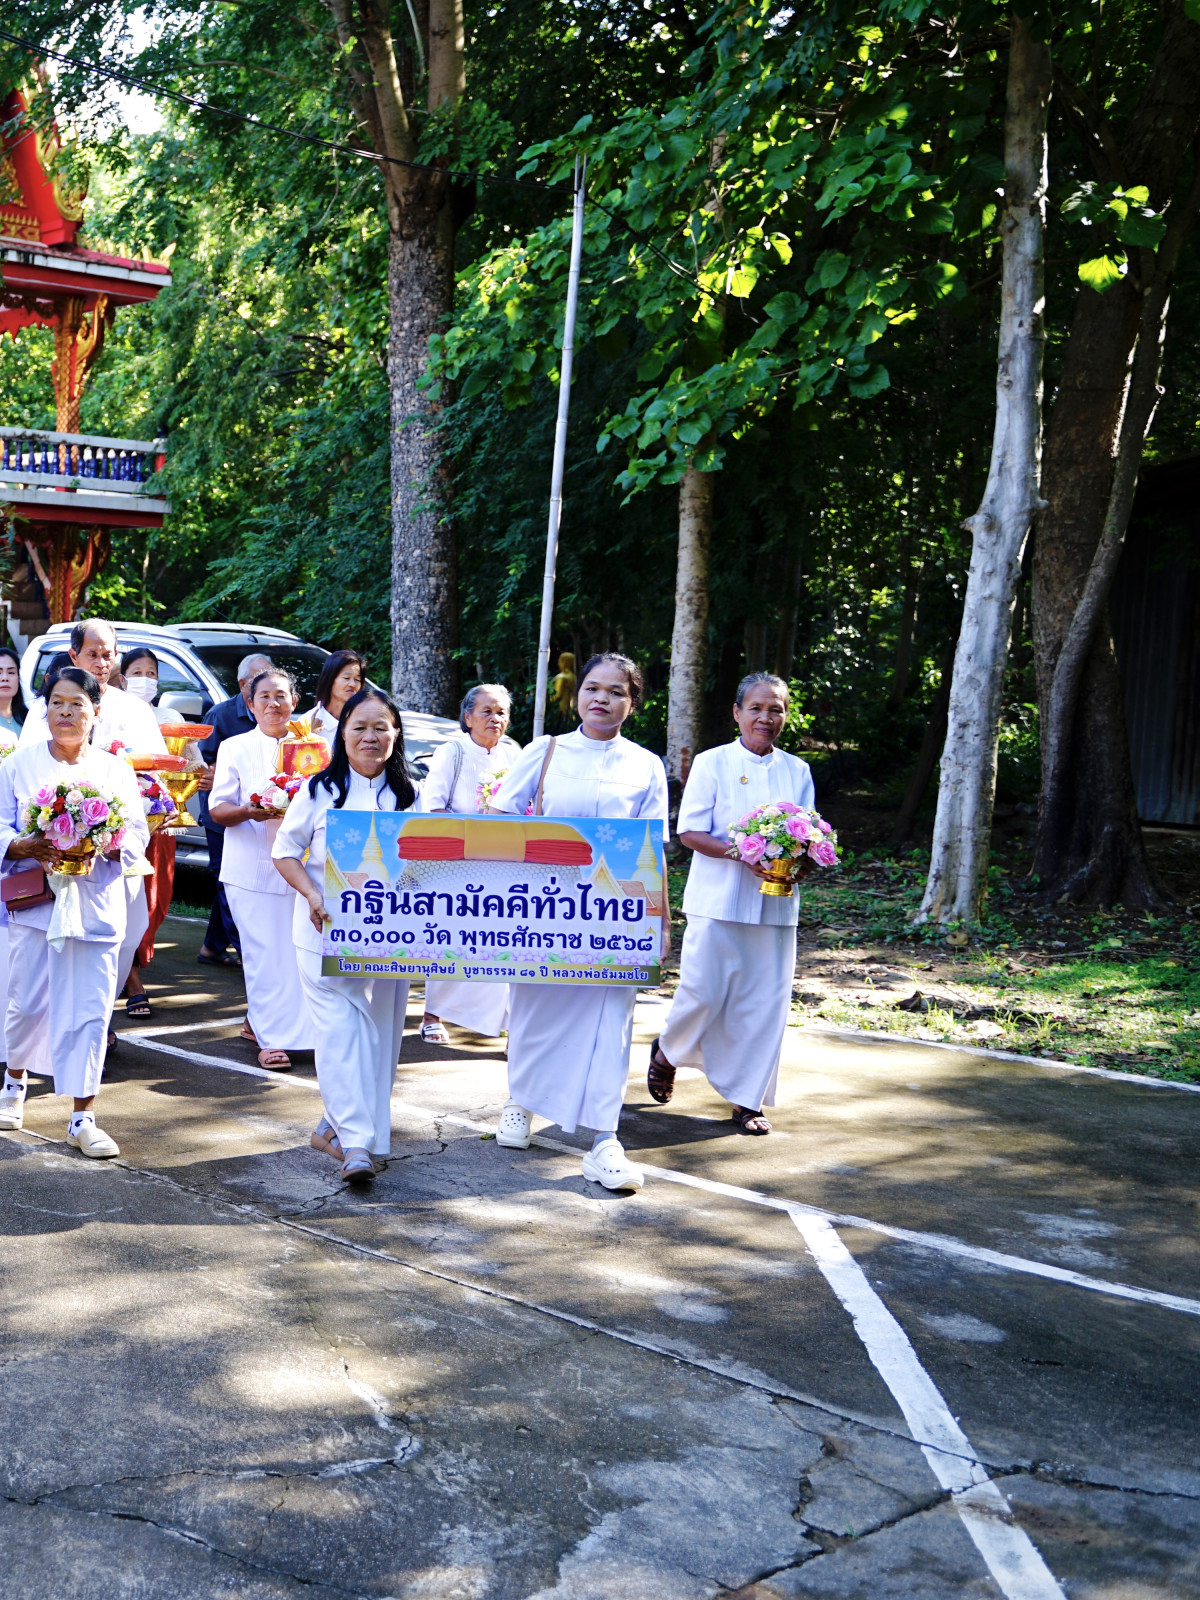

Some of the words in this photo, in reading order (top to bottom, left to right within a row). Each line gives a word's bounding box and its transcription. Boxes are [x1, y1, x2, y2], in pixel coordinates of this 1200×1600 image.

[340, 877, 645, 924] กฐินสามัคคีทั่วไทย
[330, 927, 416, 946] ๓๐,๐๐๐
[423, 923, 451, 945] วัด
[459, 925, 582, 954] พุทธศักราช
[589, 934, 653, 951] ๒๕๖๘
[338, 958, 360, 972] โดย
[364, 961, 456, 978] คณะศิษยานุศิษย์
[463, 965, 515, 978] บูชาธรรม
[539, 965, 548, 977] ปี
[552, 967, 648, 980] หลวงพ่อธัมมชโย
